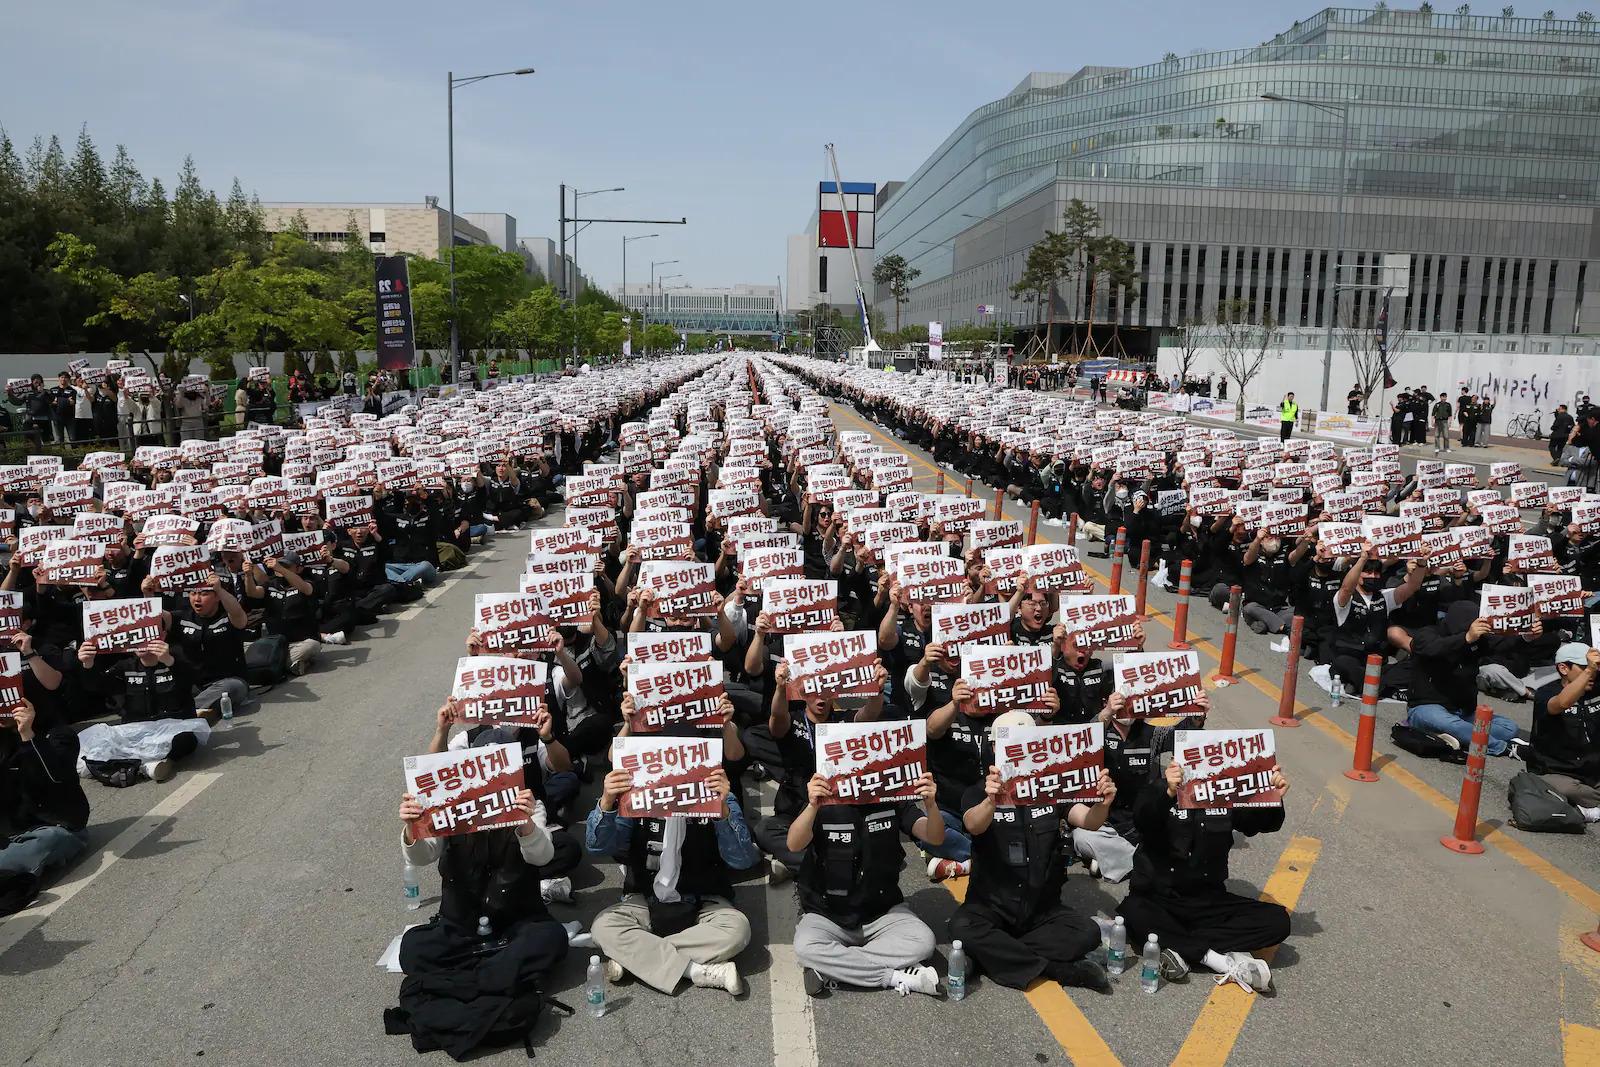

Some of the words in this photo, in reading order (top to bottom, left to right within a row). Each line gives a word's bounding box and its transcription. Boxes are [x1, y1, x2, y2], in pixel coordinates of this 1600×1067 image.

[380, 462, 412, 475] 투명하게
[877, 468, 908, 482] 투명하게
[569, 478, 605, 492] 투명하게
[812, 478, 845, 490] 투명하게
[1515, 484, 1546, 497] 투명하게
[48, 489, 87, 503] 투명하게
[184, 495, 219, 508] 투명하게
[572, 493, 608, 506] 바꾸고!!!
[640, 491, 678, 510] 투명하게
[716, 496, 754, 512] 투명하게
[837, 492, 874, 507] 투명하게
[1193, 491, 1224, 501] 투명하게
[1328, 496, 1360, 507] 투명하게
[330, 498, 366, 514] 투명하게
[940, 501, 980, 517] 투명하게
[1265, 506, 1302, 521] 투명하게
[1403, 504, 1436, 518] 투명하게
[1487, 508, 1517, 521] 투명하게
[76, 518, 118, 531] 투명하게
[147, 520, 192, 530] 투명하게
[335, 513, 372, 526] 바꾸고!!!
[569, 510, 609, 527] 투명하게
[852, 510, 894, 527] 투명하게
[636, 525, 683, 542] 투명하게
[731, 520, 773, 535] 투명하게
[870, 525, 914, 543] 투명하게
[975, 522, 1019, 542] 투명하게
[1270, 522, 1306, 535] 바꾸고!!!
[1372, 520, 1416, 539] 투명하게
[22, 528, 65, 547] 투명하게
[535, 530, 582, 551] 투명하게
[1514, 539, 1549, 553] 투명하게
[47, 545, 96, 560] 투명하게
[642, 543, 688, 559] 바꾸고!!!
[1378, 539, 1422, 556] 바꾸고!!!
[154, 547, 202, 568] 투명하게
[748, 552, 797, 572] 투명하게
[49, 565, 97, 581] 바꾸고!!!
[652, 565, 708, 591] 투명하게
[903, 560, 958, 579] 투명하게
[159, 570, 211, 588] 바꾸고!!!
[1533, 578, 1577, 595] 투명하게
[769, 582, 829, 606] 투명하게
[909, 583, 963, 600] 바꾸고!!!
[480, 598, 543, 625] 투명하게
[1067, 597, 1128, 624] 투명하게
[1540, 597, 1583, 613] 바꾸고!!!
[89, 601, 152, 627] 투명하게
[776, 608, 834, 629] 바꾸고!!!
[939, 606, 1002, 634] 투명하게
[97, 625, 160, 650] 바꾸고!!!
[487, 625, 550, 649] 바꾸고!!!
[1075, 623, 1134, 648] 바꾸고!!!
[635, 636, 703, 663] 투명하게
[792, 634, 866, 667] 투명하게
[968, 650, 1043, 680] 투명하게
[1122, 655, 1190, 687] 투명하게
[460, 664, 536, 690] 투명하게
[636, 665, 712, 699] 투명하게
[803, 665, 875, 695] 바꾸고!!!
[978, 681, 1050, 708] 바꾸고!!!
[1132, 685, 1199, 714] 바꾸고!!!
[465, 696, 540, 721] 바꾸고!!!
[646, 697, 721, 727] 바꾸고!!!
[825, 725, 914, 765] 투명하게
[953, 732, 971, 743] 투쟁
[1005, 727, 1092, 767] 투명하게
[1184, 733, 1265, 770] 투명하게
[621, 742, 710, 776] 투명하게
[1129, 758, 1146, 766] SELU
[415, 748, 509, 798] 투명하게
[837, 762, 922, 799] 바꾸고!!!
[1016, 765, 1101, 799] 바꾸고!!!
[432, 786, 521, 830] 바꾸고!!!
[1031, 806, 1053, 818] SELU
[994, 812, 1015, 822] 투쟁
[869, 821, 891, 832] SELU
[828, 832, 852, 842] 투쟁
